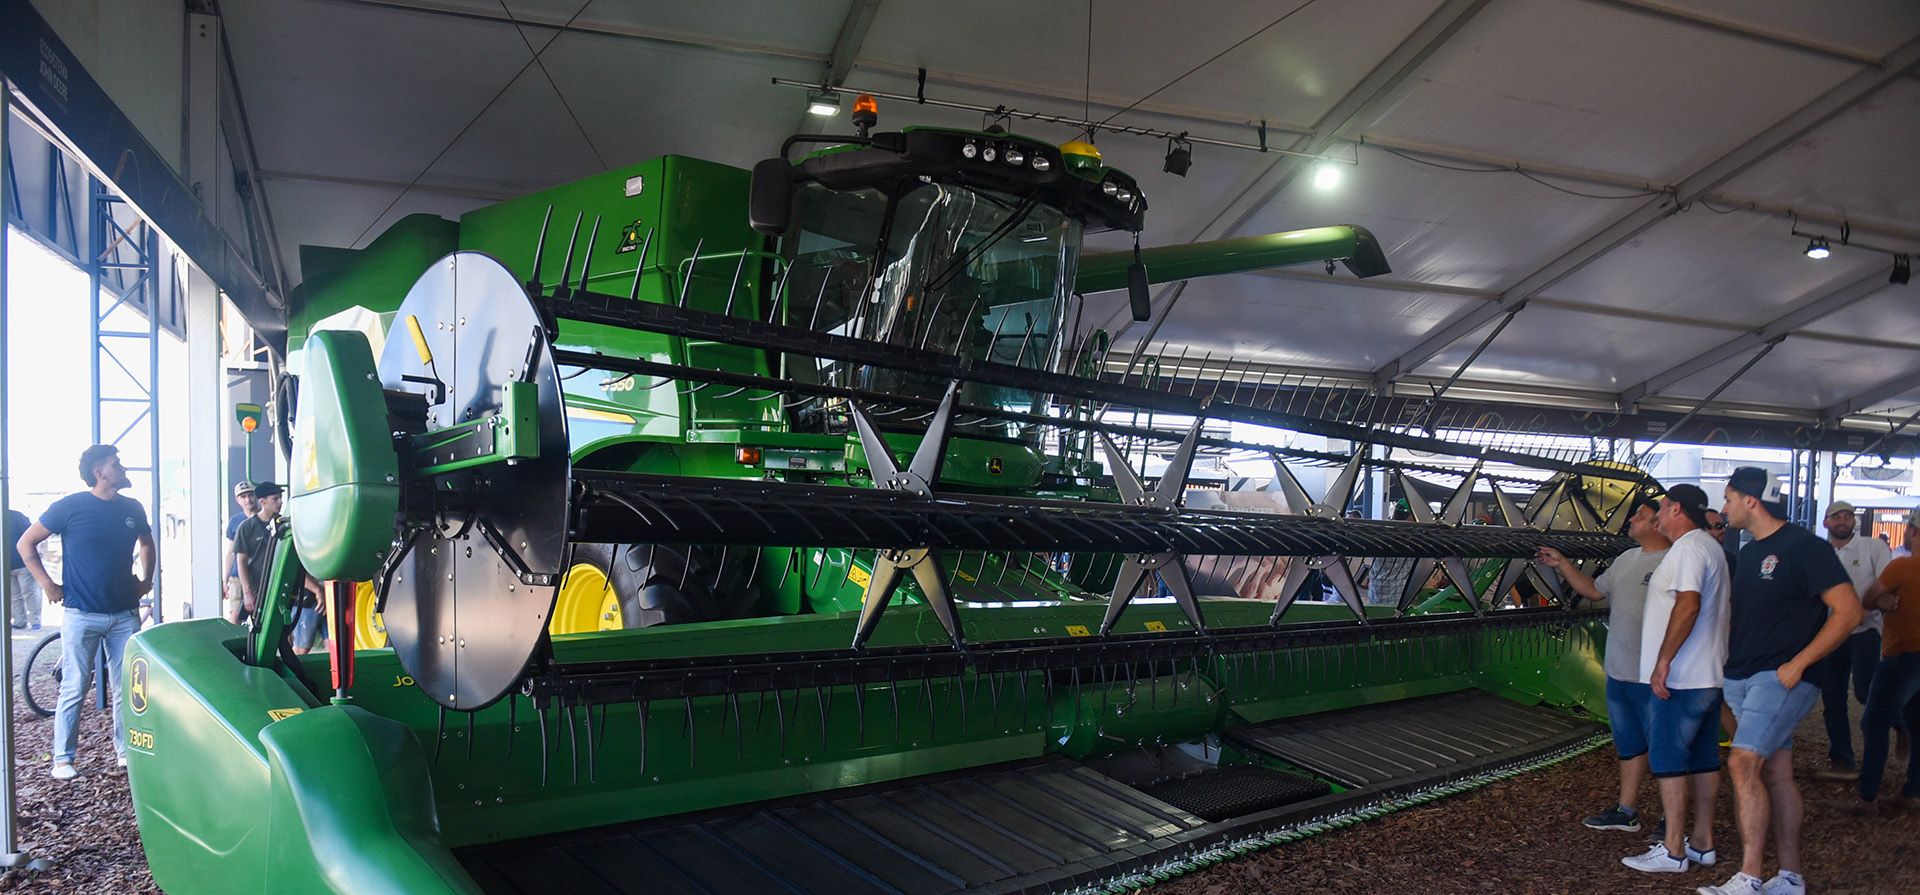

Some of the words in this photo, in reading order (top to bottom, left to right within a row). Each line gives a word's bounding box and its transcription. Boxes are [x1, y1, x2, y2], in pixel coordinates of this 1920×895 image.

[39, 61, 53, 85] JOHN
[53, 73, 68, 101] DEERE
[129, 729, 154, 749] 730FD
